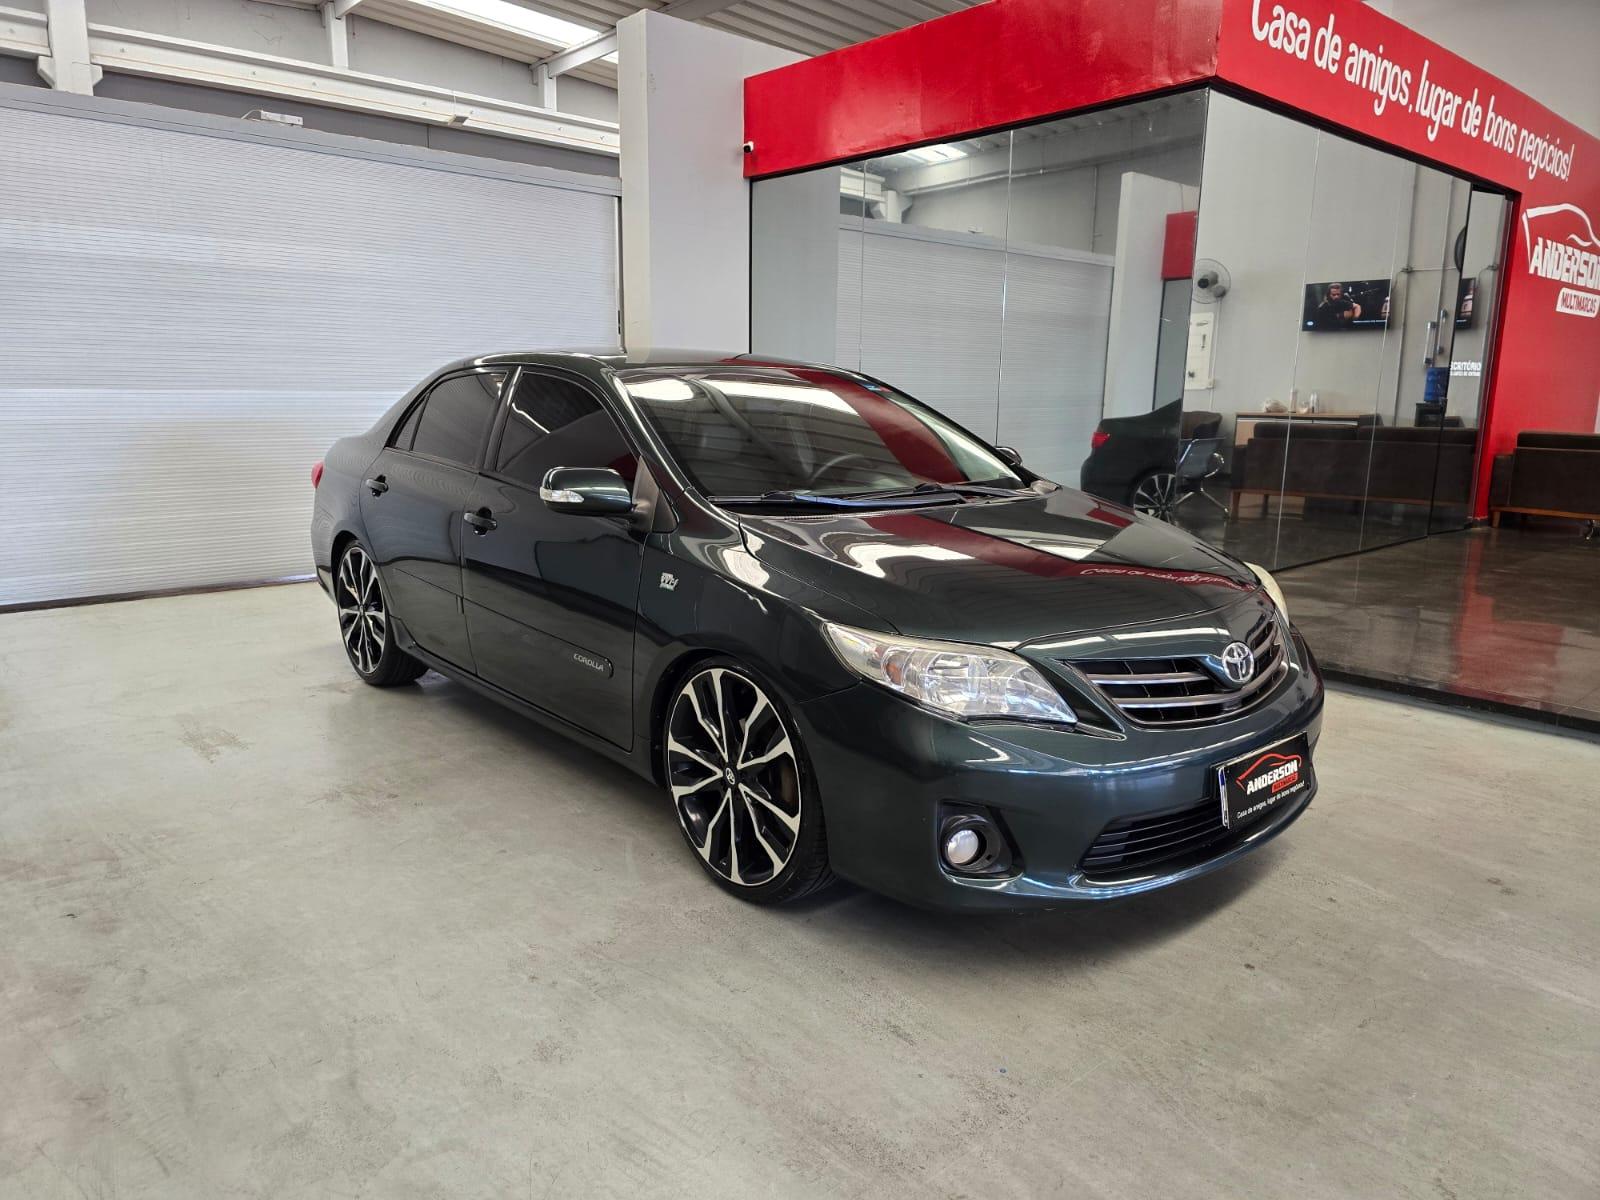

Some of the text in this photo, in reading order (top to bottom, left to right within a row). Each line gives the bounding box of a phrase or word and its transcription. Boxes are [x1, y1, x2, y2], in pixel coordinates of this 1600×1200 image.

[1252, 0, 1576, 183] Casa de amigos, lugar de bons negócios!
[573, 654, 603, 672] COROLLA
[1247, 760, 1298, 795] ANDERSON
